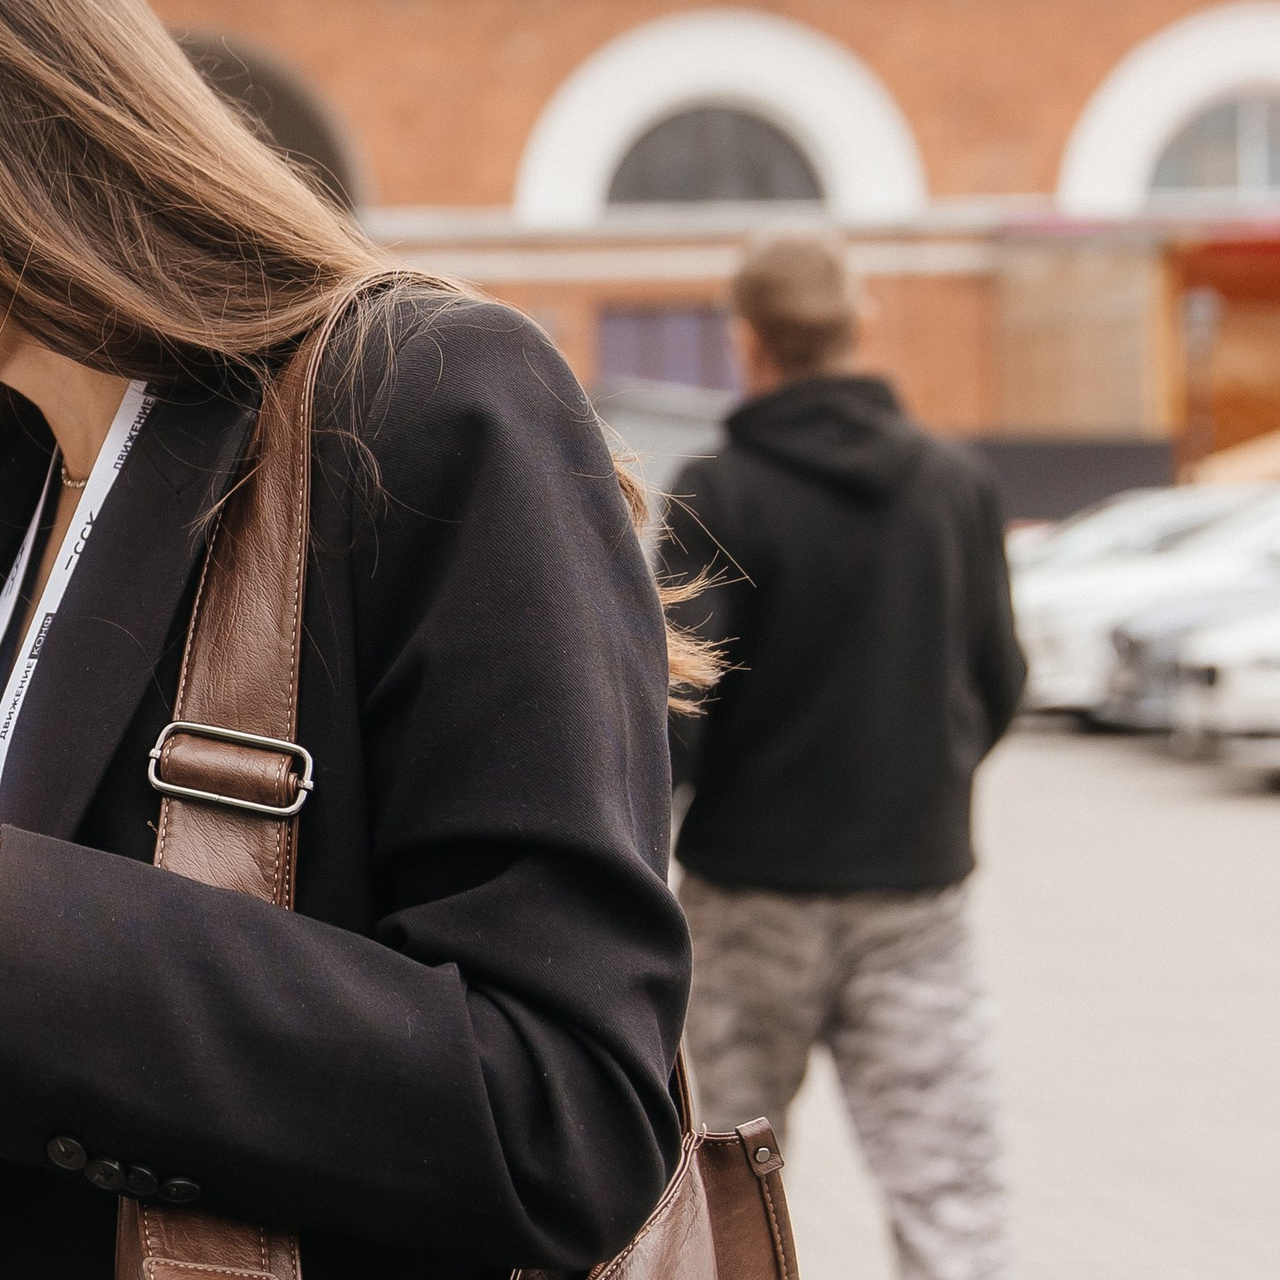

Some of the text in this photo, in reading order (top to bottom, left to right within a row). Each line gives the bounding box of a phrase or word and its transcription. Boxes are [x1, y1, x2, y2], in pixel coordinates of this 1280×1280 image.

[113, 397, 155, 471] ДВИЖЕНИЕ
[0, 615, 53, 740] ДВИЖЕНИЕ КОНФ
